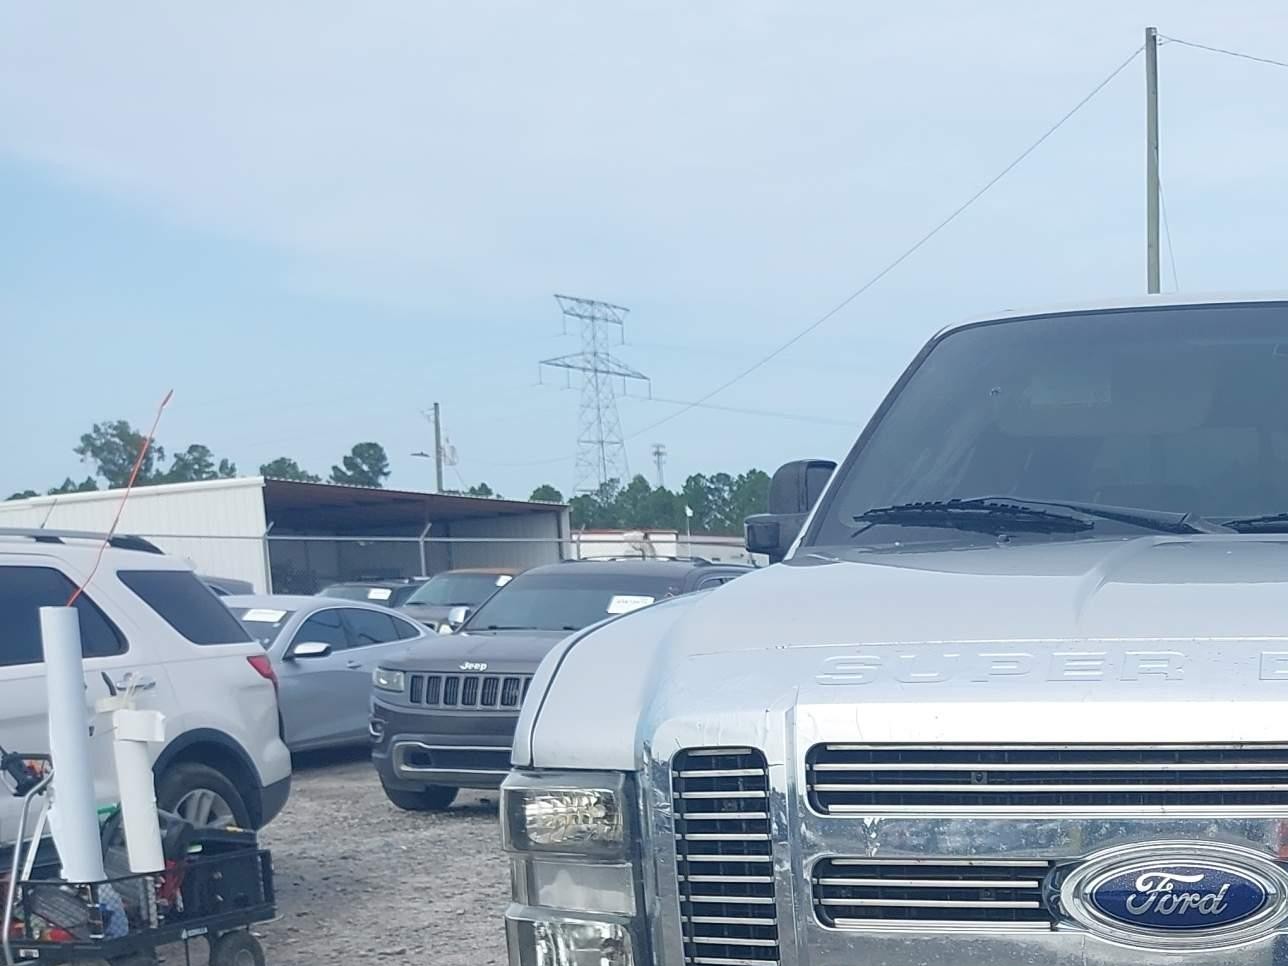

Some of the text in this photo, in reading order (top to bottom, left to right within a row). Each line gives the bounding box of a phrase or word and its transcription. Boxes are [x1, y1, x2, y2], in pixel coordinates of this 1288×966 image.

[458, 661, 488, 672] Jeep
[815, 651, 1185, 686] SUPER
[1125, 871, 1229, 915] Ford
